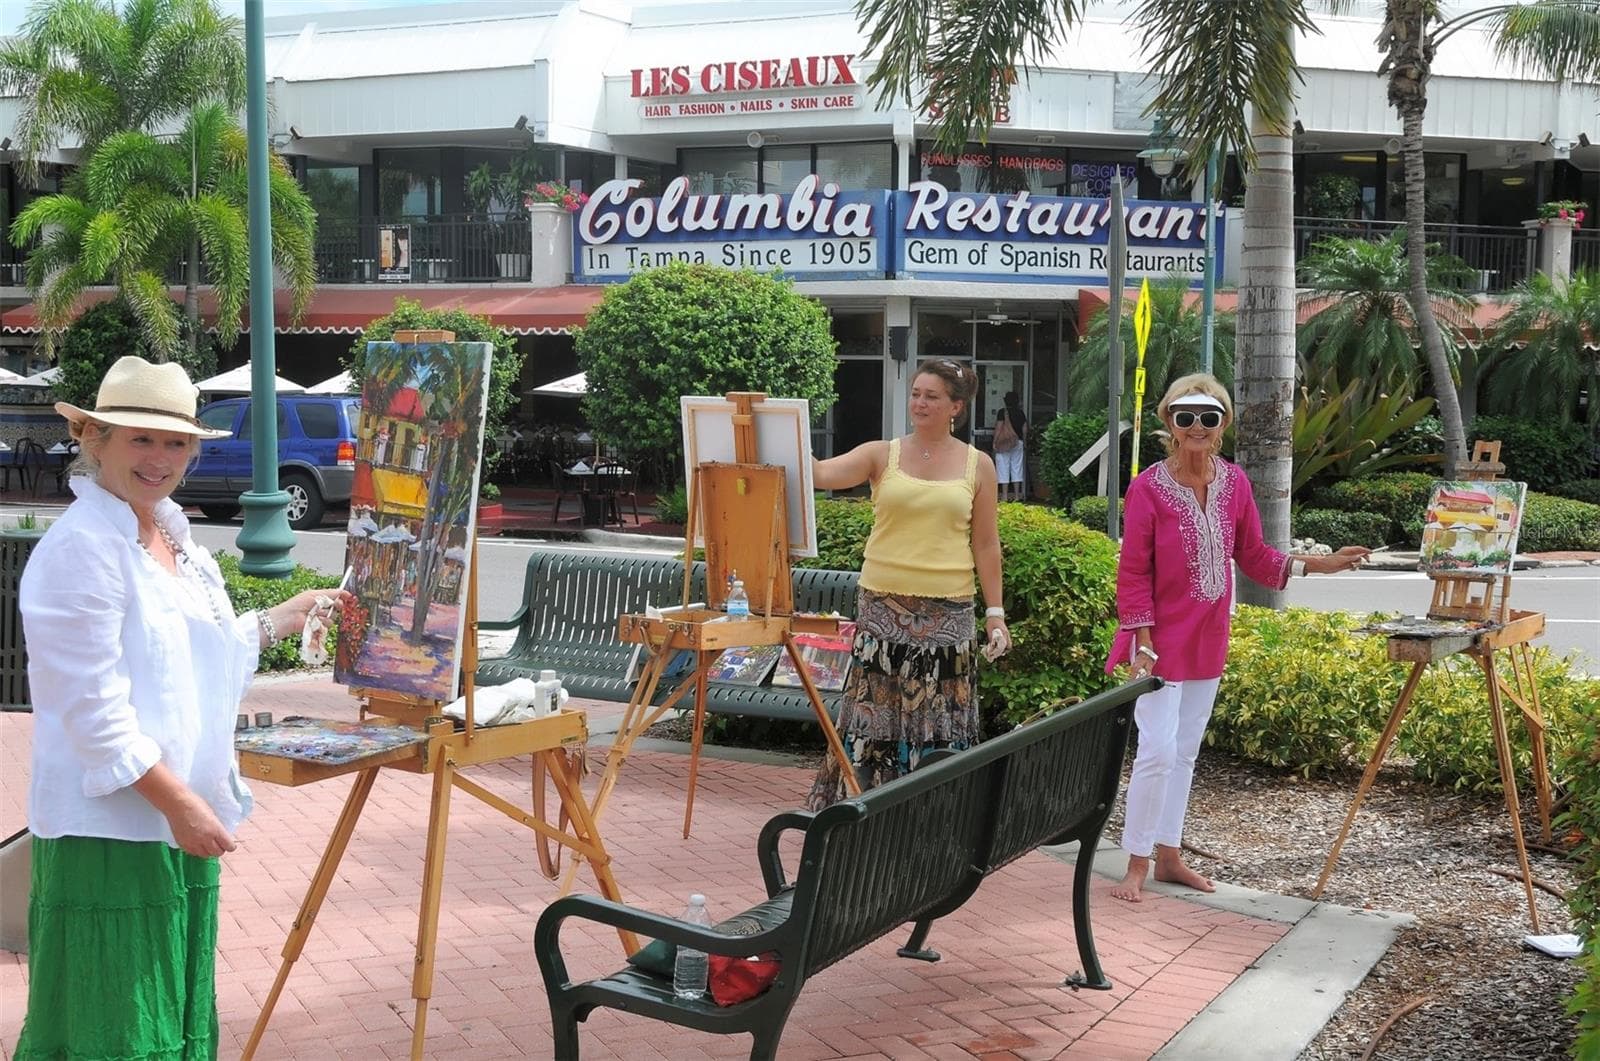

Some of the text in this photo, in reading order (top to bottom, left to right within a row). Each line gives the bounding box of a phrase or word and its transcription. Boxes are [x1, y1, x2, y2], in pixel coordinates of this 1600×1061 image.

[630, 54, 857, 98] LES CISEAUX
[644, 95, 854, 117] HAIR FASHION NAILS SKIN CARE
[920, 152, 1064, 172] SUNGLASSES HANDBAGS
[1071, 163, 1136, 178] DESIGNER
[578, 173, 873, 245] Columbia
[588, 241, 872, 269] In Tampa Since 1905
[908, 240, 1206, 273] Gem of Spanish Rtaurants
